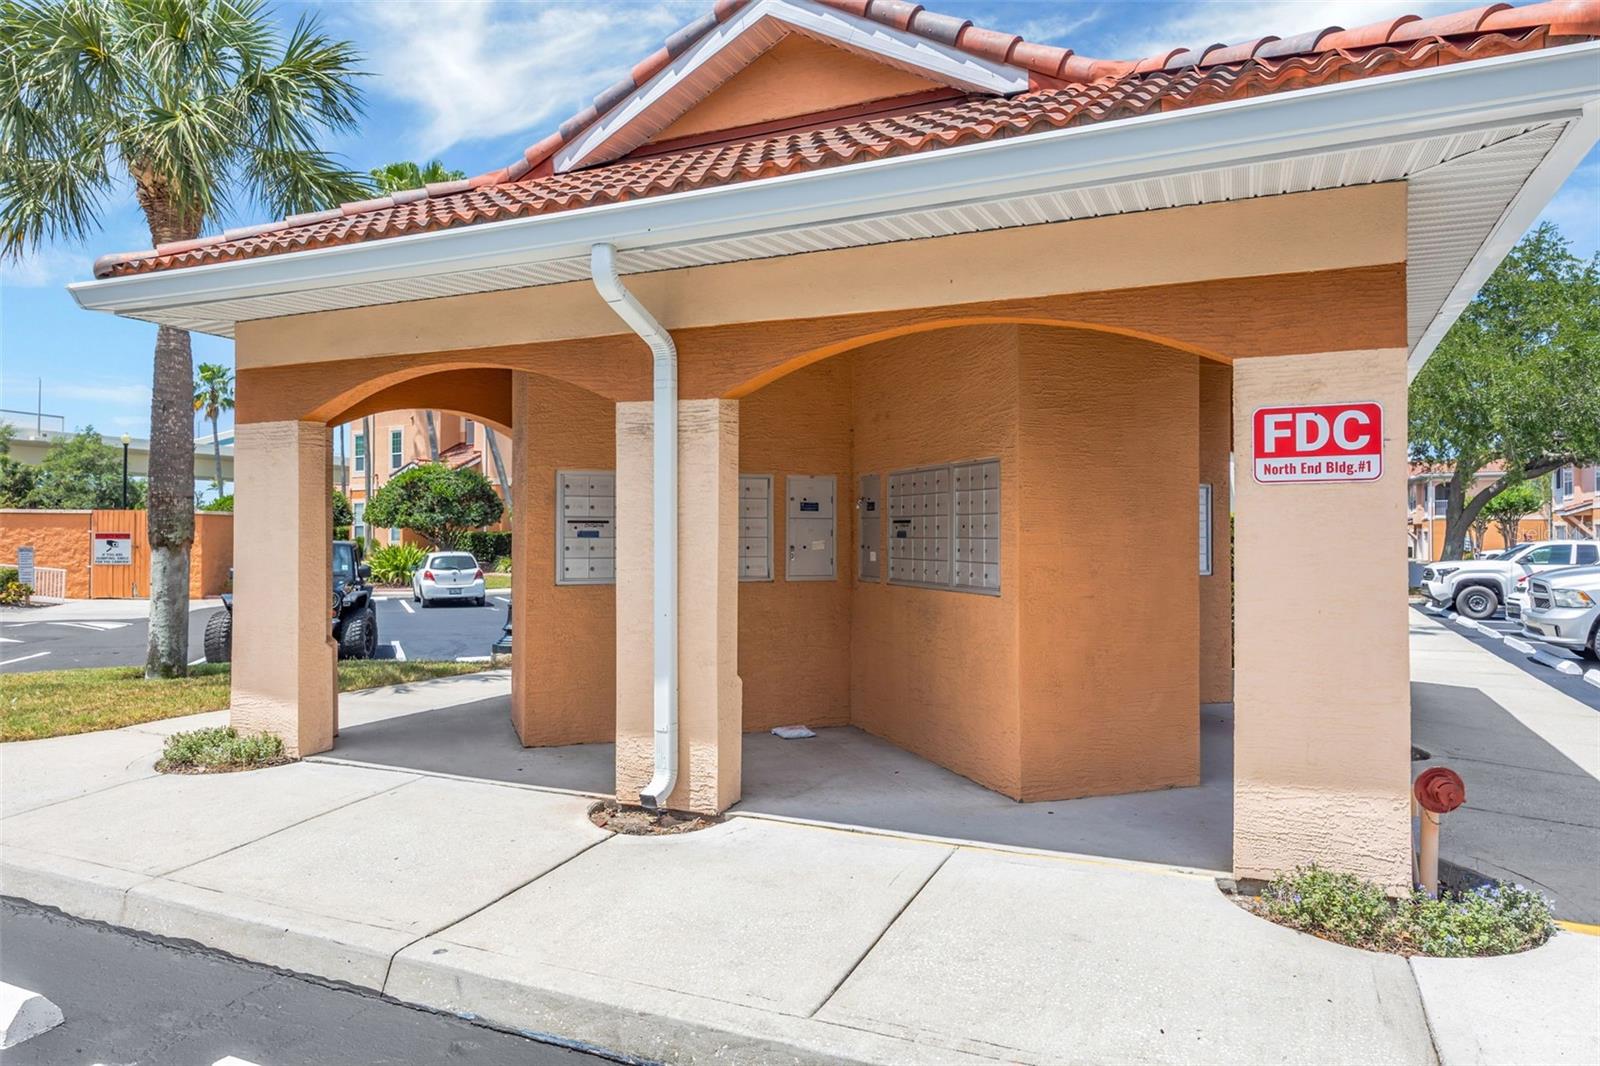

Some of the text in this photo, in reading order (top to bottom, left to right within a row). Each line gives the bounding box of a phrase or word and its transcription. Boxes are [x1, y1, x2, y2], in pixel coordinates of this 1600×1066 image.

[1263, 409, 1371, 453] FDC
[1263, 460, 1372, 476] North End Bldg.#1
